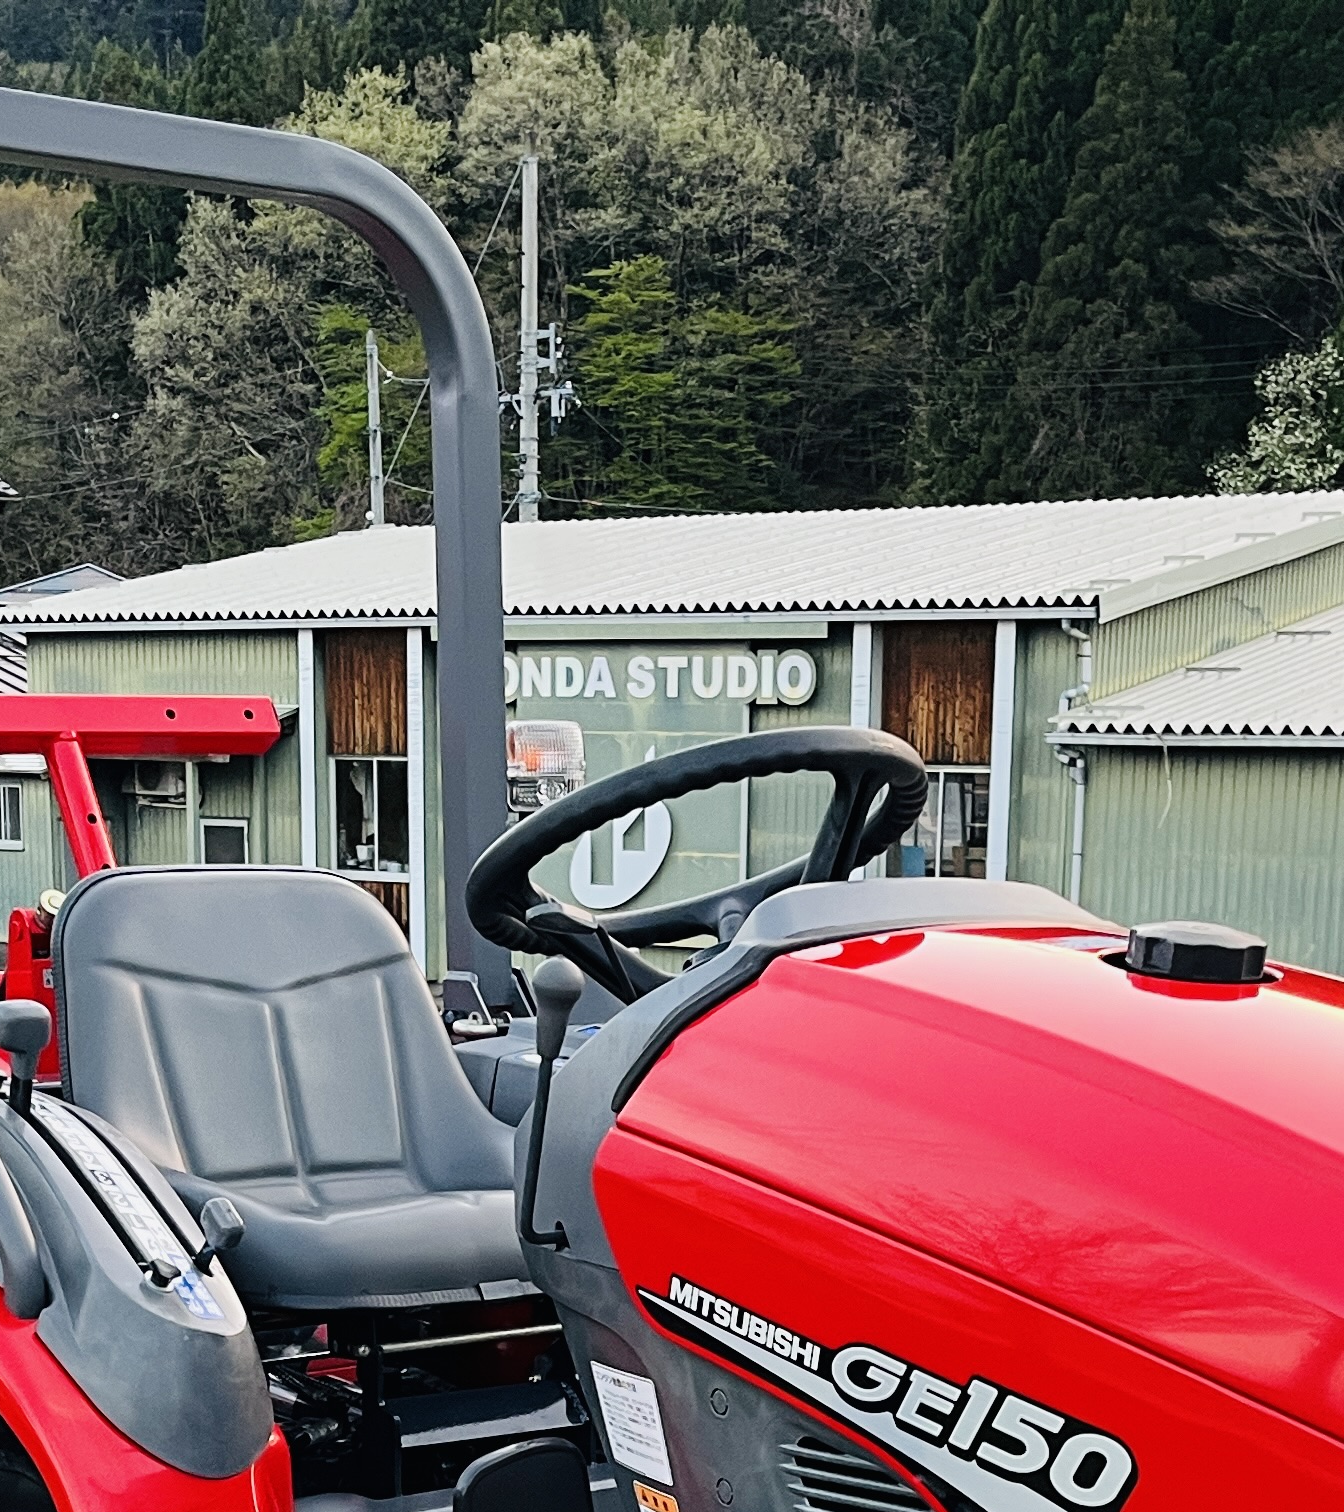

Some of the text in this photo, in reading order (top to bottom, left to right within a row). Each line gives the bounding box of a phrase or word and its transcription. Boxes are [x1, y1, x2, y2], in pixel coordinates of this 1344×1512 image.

[625, 654, 814, 700] STUDIO
[668, 1275, 1134, 1508] MITSUBISHI GE150
